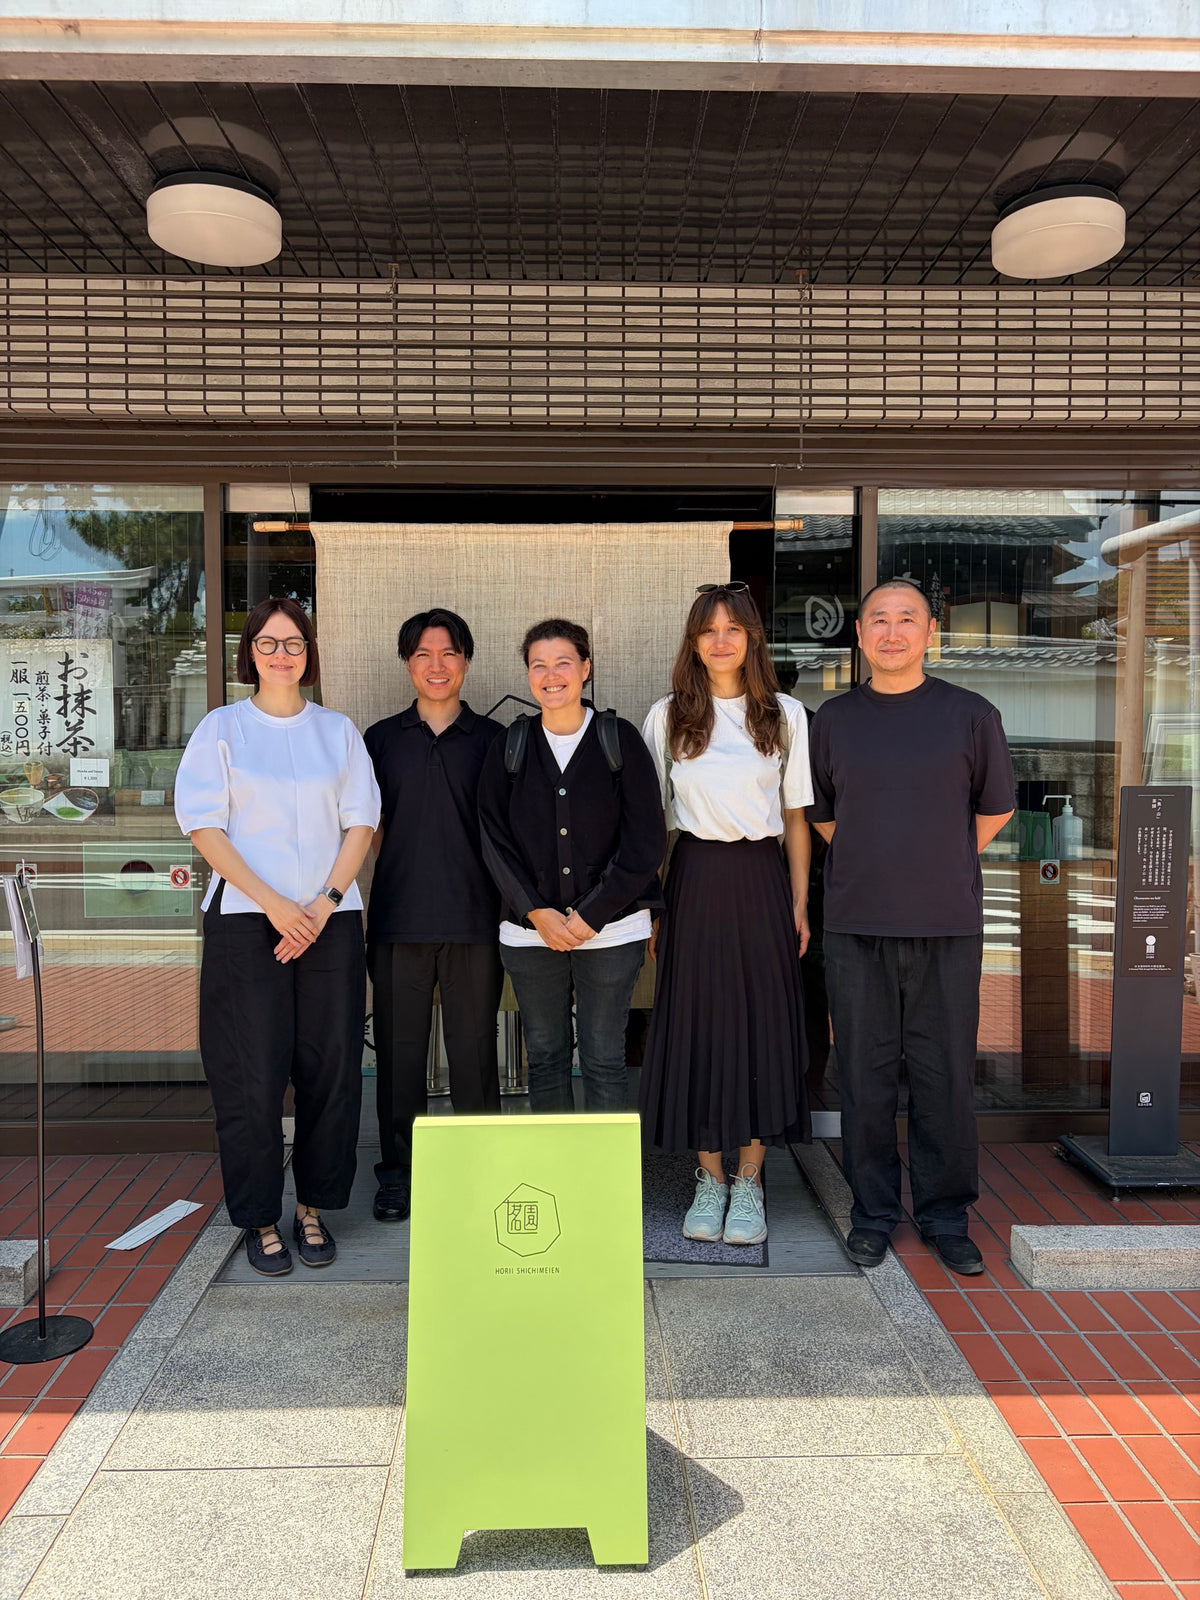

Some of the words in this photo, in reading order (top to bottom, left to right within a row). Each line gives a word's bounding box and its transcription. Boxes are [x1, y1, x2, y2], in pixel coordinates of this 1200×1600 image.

[54, 652, 97, 758] お抹茶
[516, 1266, 560, 1274] SHICHIMEIEN
